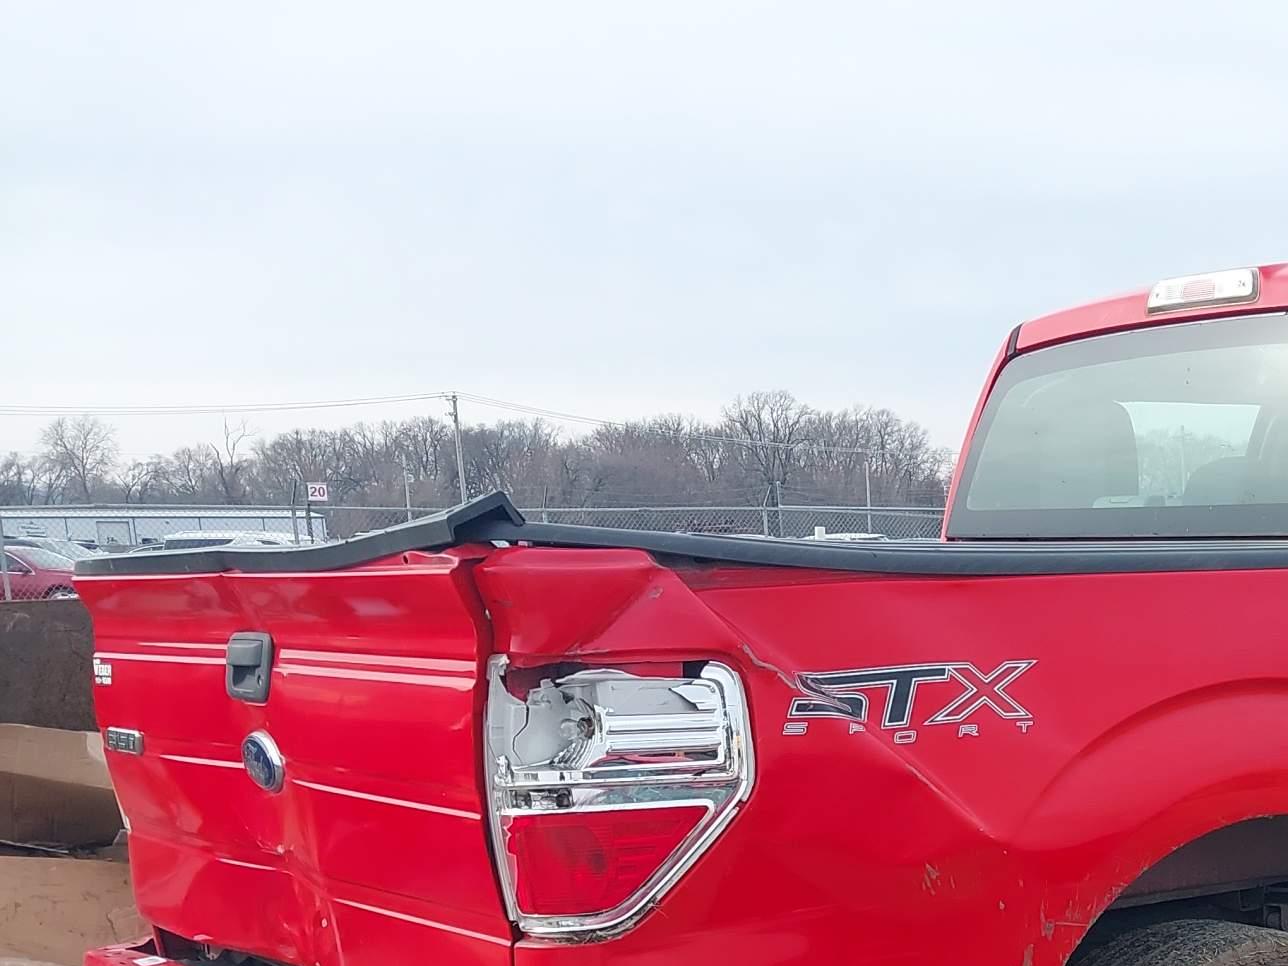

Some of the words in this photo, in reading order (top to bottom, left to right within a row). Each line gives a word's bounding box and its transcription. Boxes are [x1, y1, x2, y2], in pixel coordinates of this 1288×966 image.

[309, 486, 326, 498] 20
[787, 659, 1039, 729] STX
[782, 721, 1034, 744] SPORT
